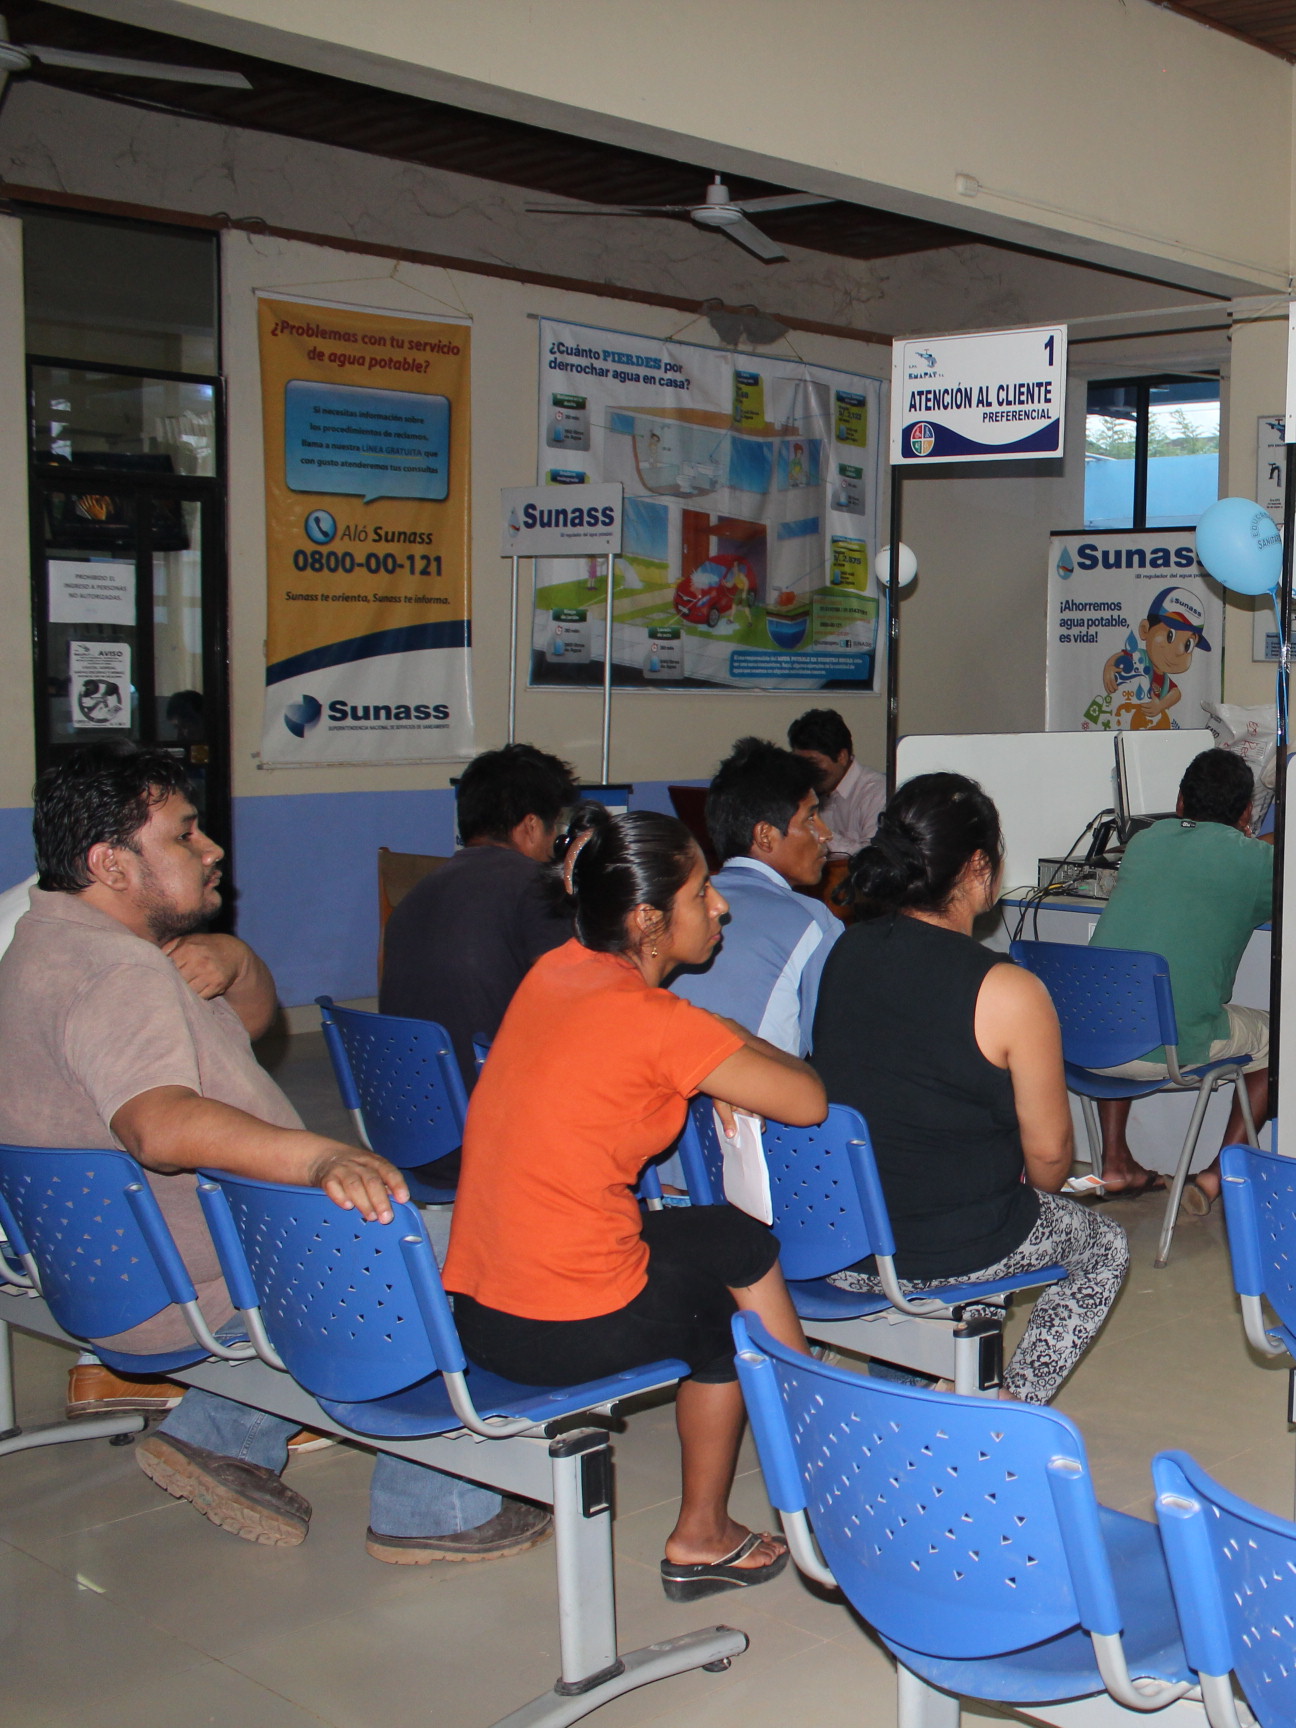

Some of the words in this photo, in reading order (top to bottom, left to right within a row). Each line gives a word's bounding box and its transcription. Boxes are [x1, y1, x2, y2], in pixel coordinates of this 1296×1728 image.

[271, 320, 358, 343] ¿Problemas
[362, 333, 387, 347] con
[390, 336, 404, 349] tu
[408, 339, 460, 356] servicio
[308, 346, 325, 361] de
[328, 353, 365, 367] agua
[368, 356, 430, 374] potable?
[549, 341, 600, 361] ¿Cuánto
[602, 350, 662, 370] PIERDES
[663, 361, 683, 374] por
[1044, 335, 1055, 366] 1
[549, 357, 610, 378] derrochar
[612, 370, 640, 383] agua
[643, 375, 656, 385] en
[658, 377, 690, 390] casa?
[908, 371, 937, 380] EMAPAT
[908, 382, 973, 413] ATENCIÓN
[976, 385, 993, 408] AL
[996, 381, 1052, 407] CLIENTE
[982, 408, 1052, 423] PREFERENCIAL
[523, 502, 615, 530] Sunass
[340, 524, 368, 542] Aló
[372, 526, 433, 545] Sunass
[293, 549, 442, 576] 0800-00-121
[1077, 543, 1204, 571] Sunas
[285, 591, 318, 601] Sunass
[321, 593, 329, 602] te
[373, 593, 401, 603] Sunass
[404, 595, 413, 604] te
[1060, 599, 1122, 613] ¡Ahorremos
[1175, 598, 1202, 617] Sunass
[1059, 618, 1085, 629] agua
[1087, 615, 1129, 629] potable,
[1059, 633, 1071, 643] es
[1073, 632, 1098, 643] vida!
[328, 700, 450, 721] Sunass
